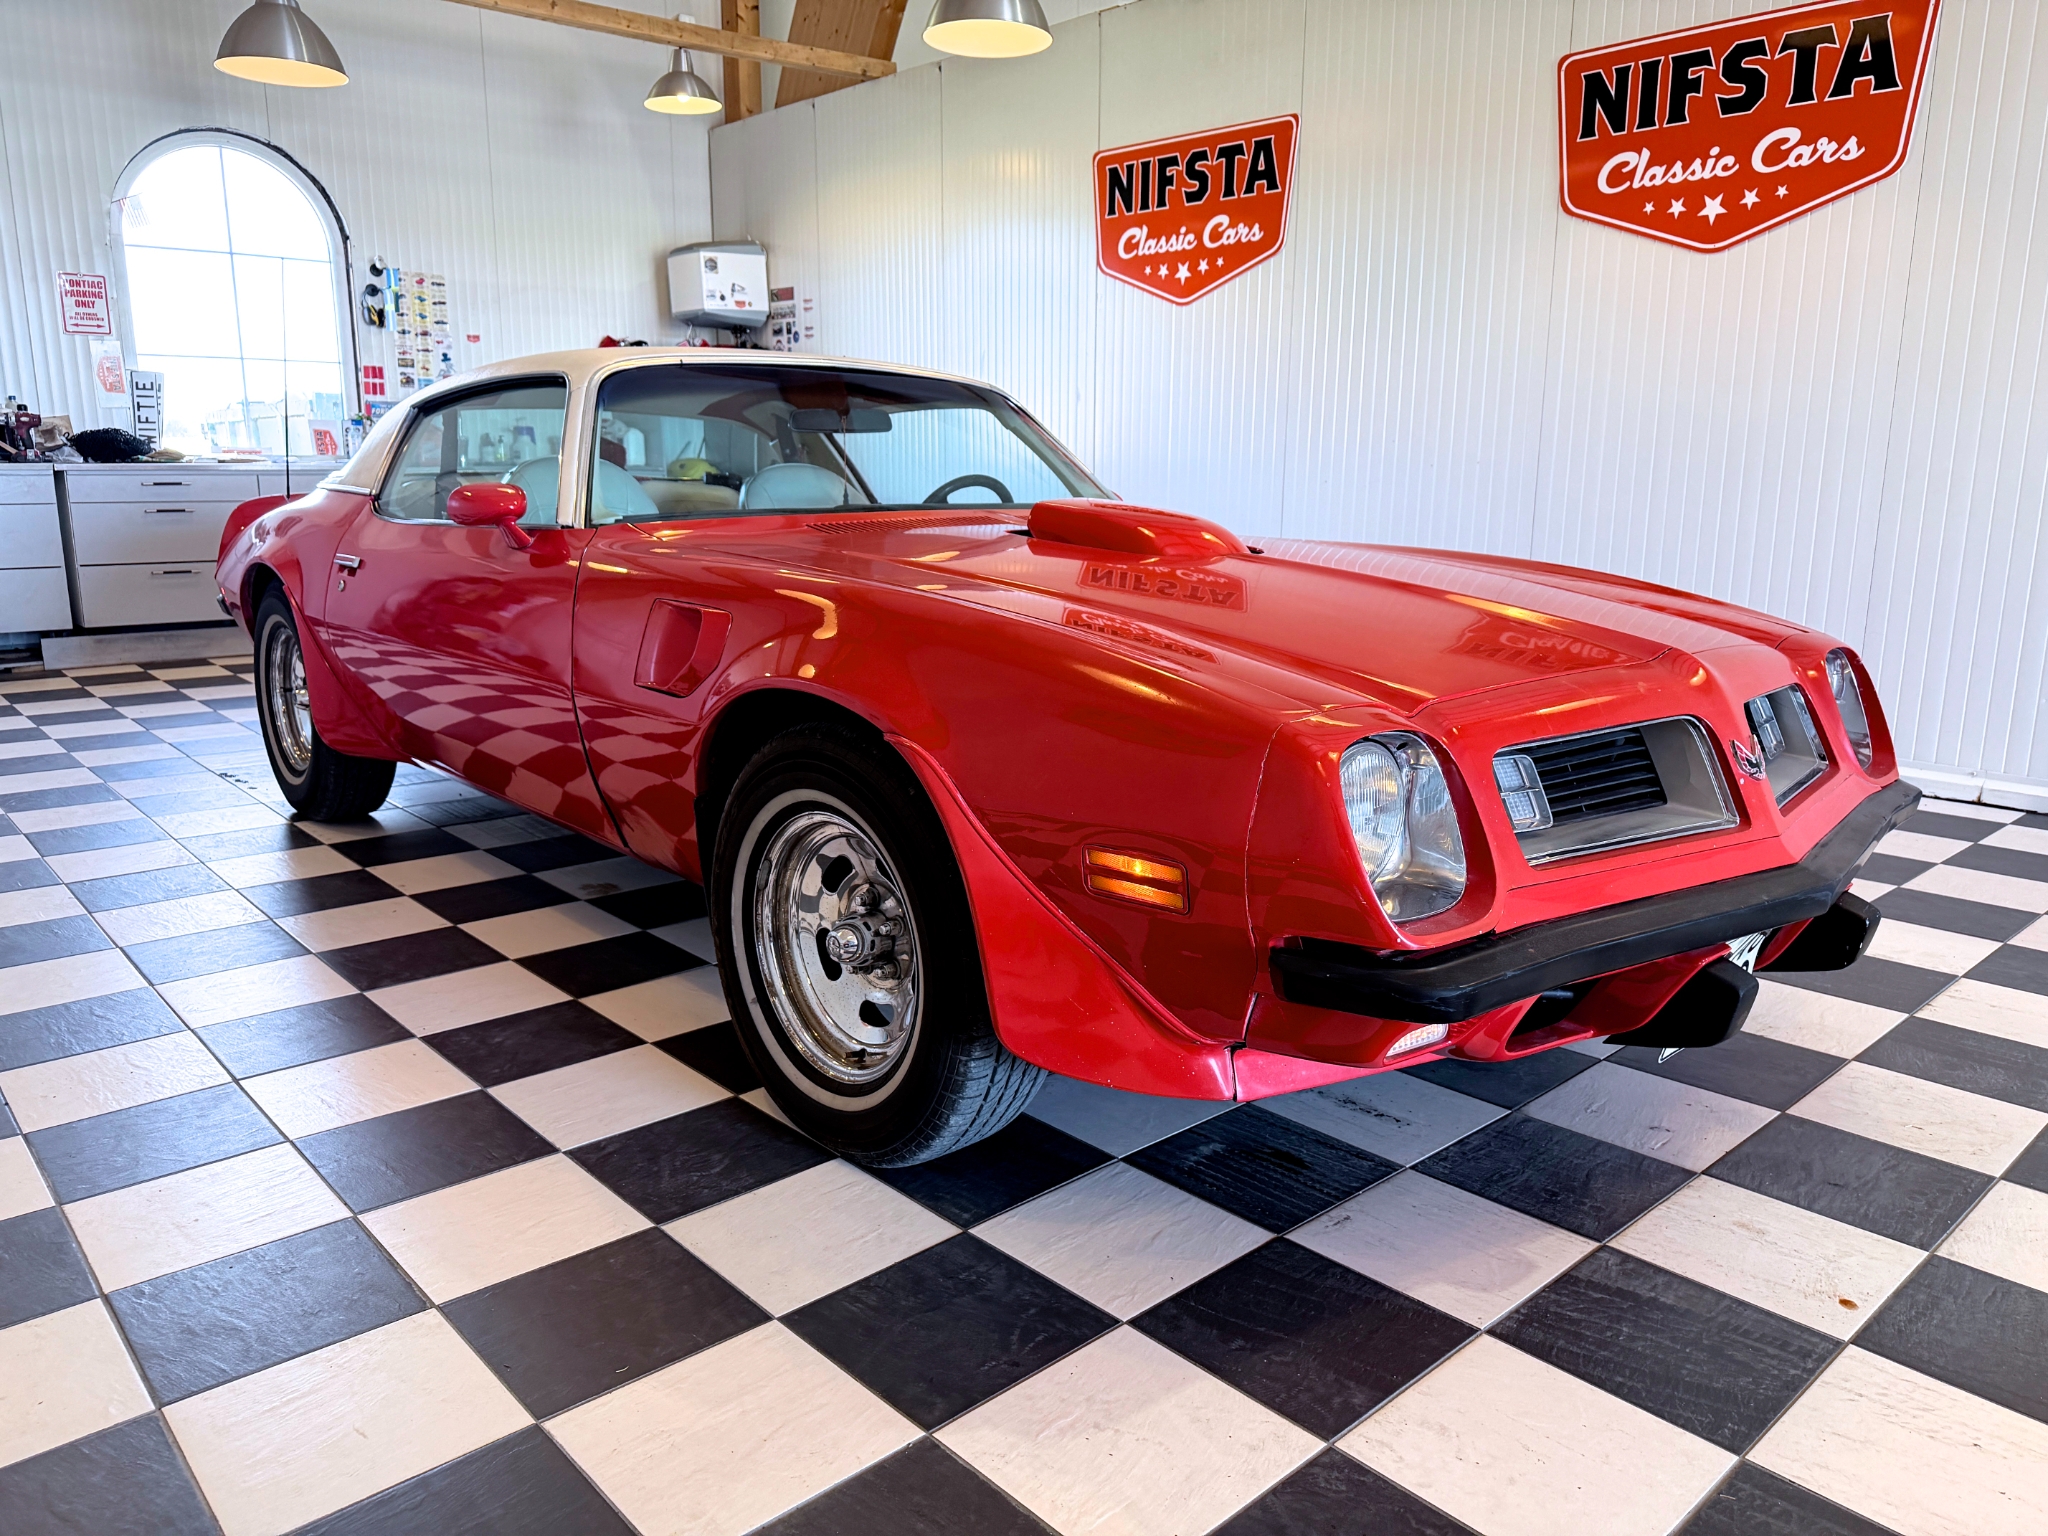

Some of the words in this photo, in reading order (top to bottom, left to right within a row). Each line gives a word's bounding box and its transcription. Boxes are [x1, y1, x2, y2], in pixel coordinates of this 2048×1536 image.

[1577, 12, 1903, 142] NIFSTA
[1105, 135, 1281, 218] NIFSTA
[1597, 146, 1739, 195] Classic
[1750, 126, 1866, 174] Cars
[1118, 225, 1198, 260] Classic
[1202, 214, 1264, 249] Cars
[64, 289, 104, 300] PARKING
[74, 299, 96, 309] ONLY
[135, 381, 157, 452] WIFTIE
[316, 431, 326, 456] IFSTA
